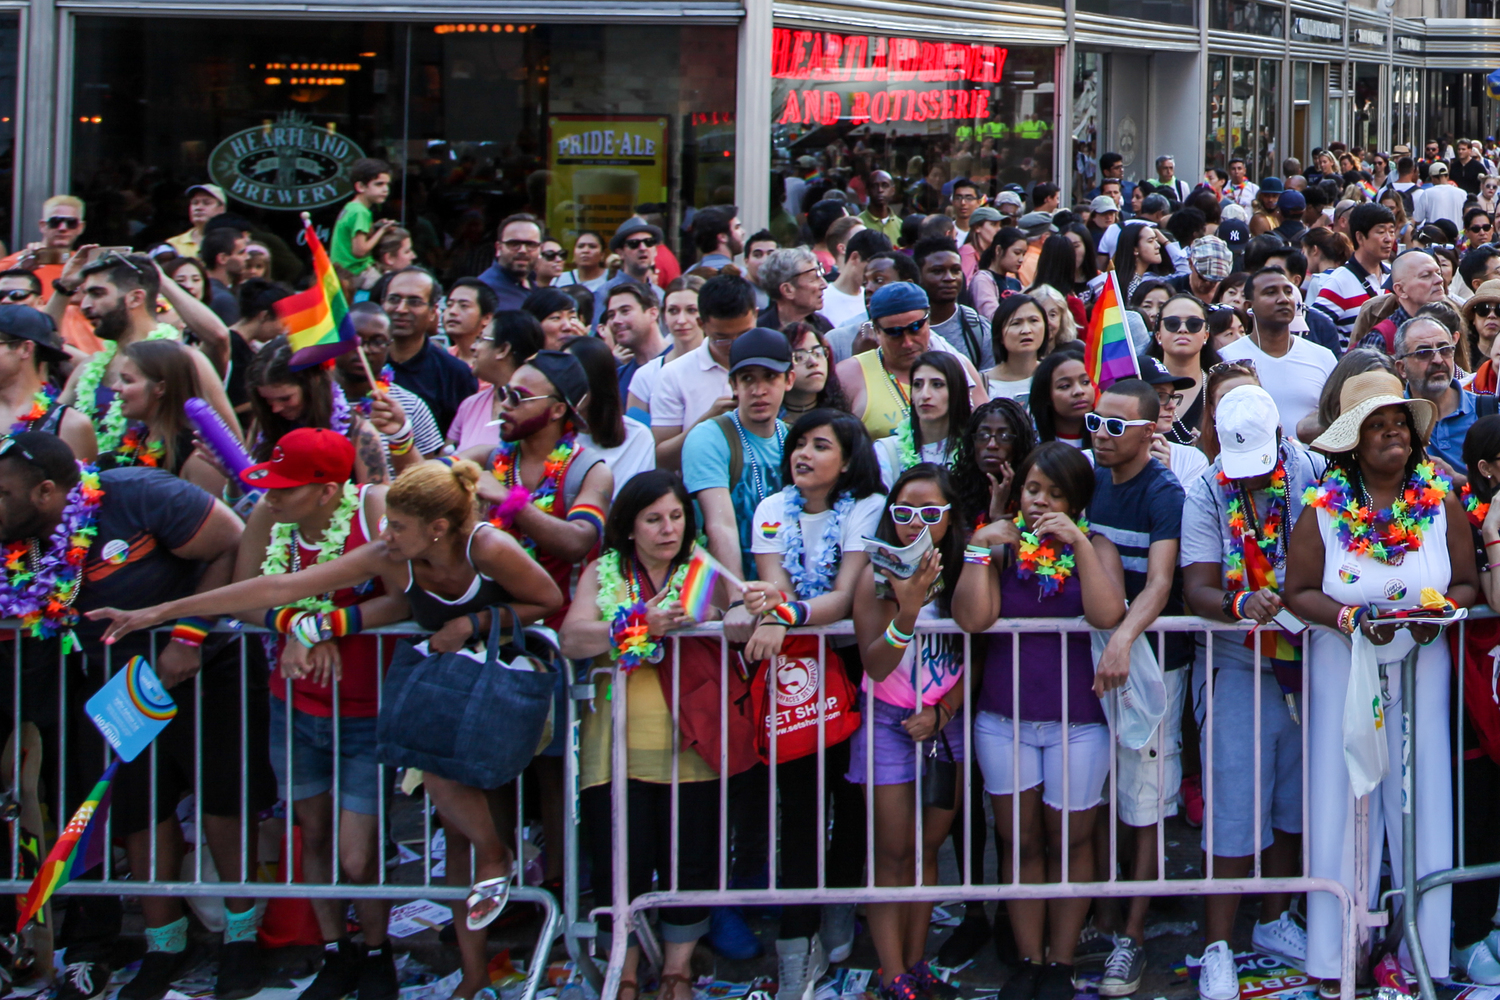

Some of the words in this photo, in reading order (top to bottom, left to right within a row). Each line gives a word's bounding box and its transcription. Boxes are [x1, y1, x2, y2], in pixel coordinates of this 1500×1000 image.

[770, 27, 921, 82] HEARTLAND
[919, 41, 1009, 83] BREWERY
[778, 89, 842, 126] AND
[851, 89, 992, 126] ROTISSERIE
[230, 127, 349, 159] HEARTLAND
[230, 177, 338, 205] BREWERY
[93, 713, 122, 749] amazon
[765, 709, 791, 728] SET
